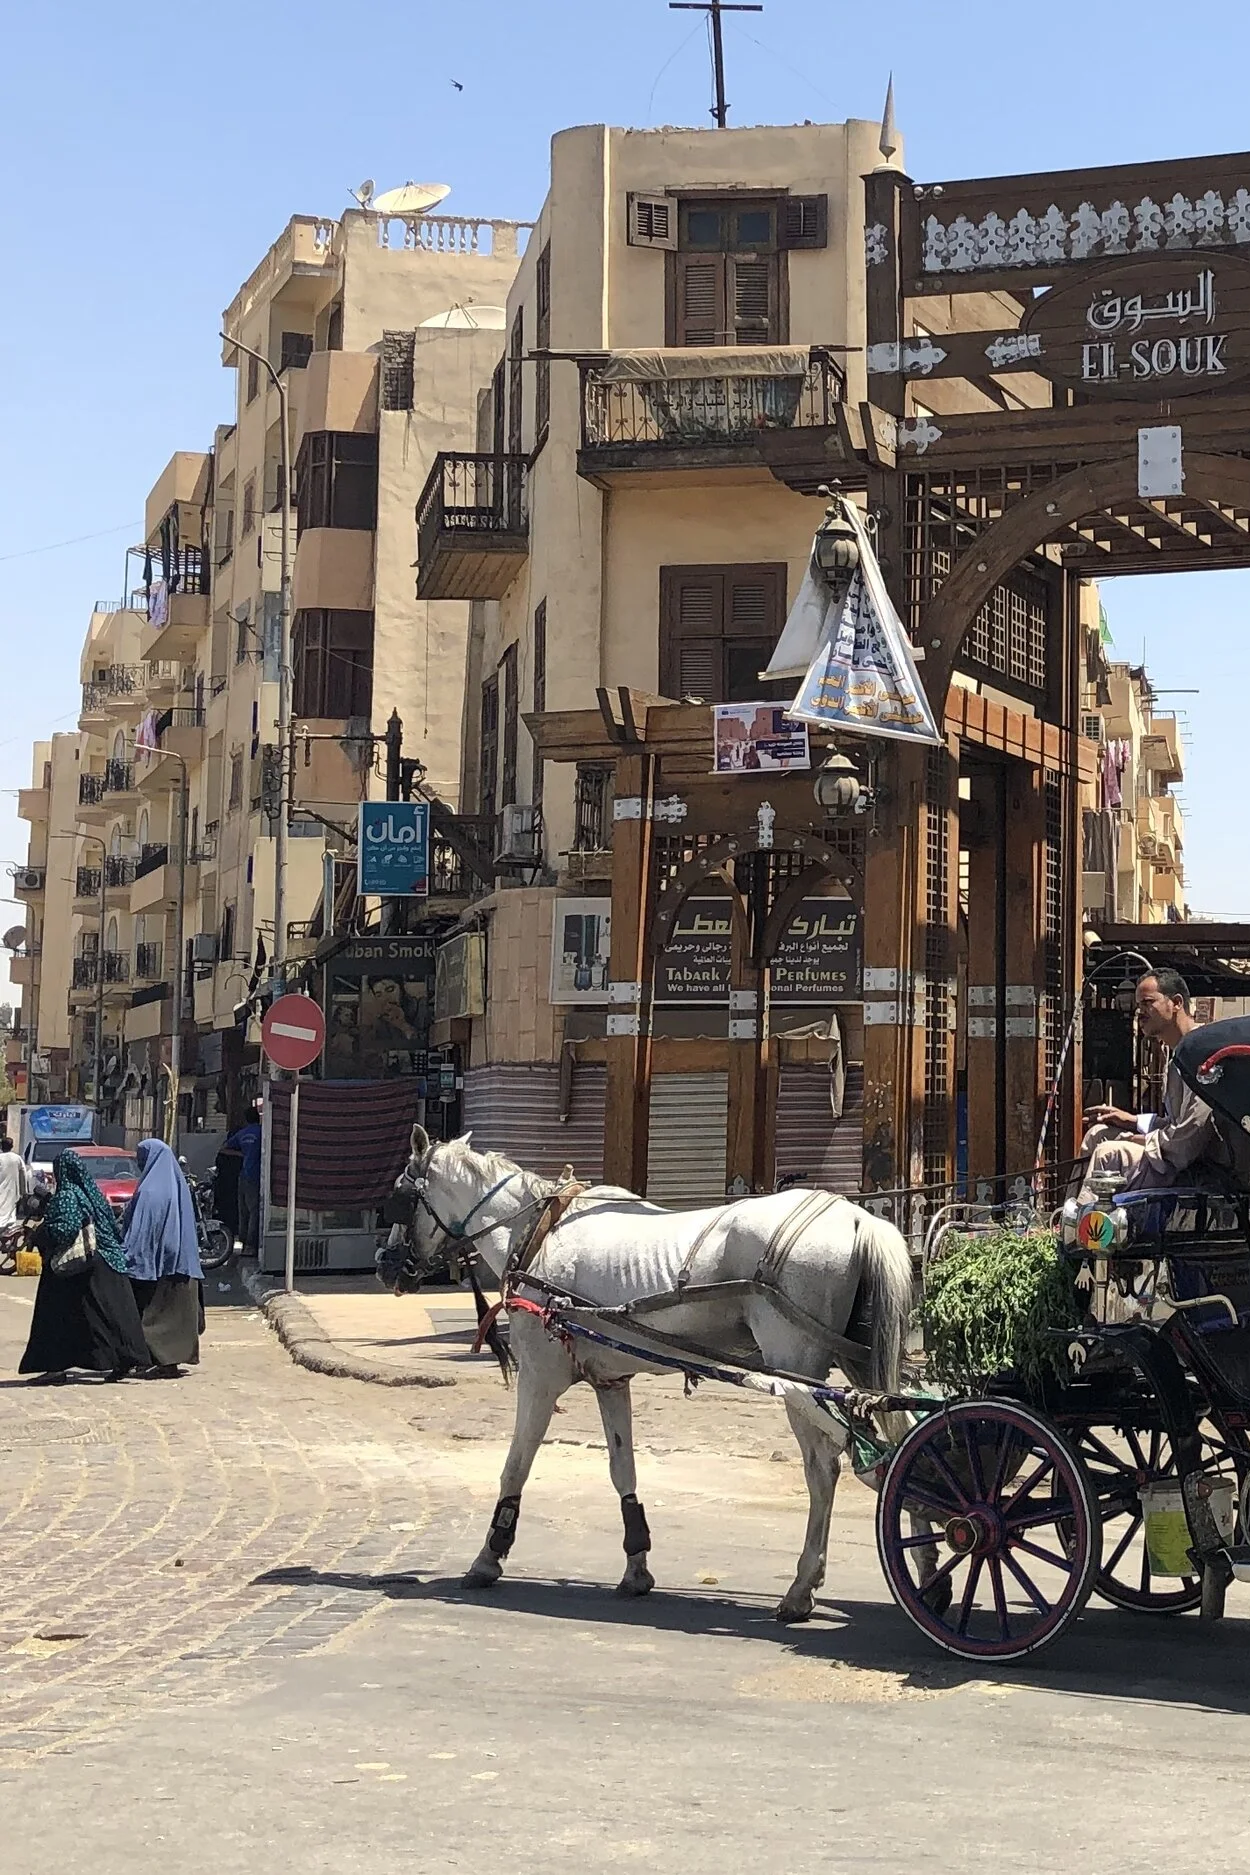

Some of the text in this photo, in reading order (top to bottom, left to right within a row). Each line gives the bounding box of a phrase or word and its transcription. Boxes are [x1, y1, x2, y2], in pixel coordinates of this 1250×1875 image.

[1086, 268, 1215, 333] السوق
[366, 805, 425, 843] أمان
[788, 914, 858, 941] تبارك
[342, 943, 382, 959] uban
[778, 942, 799, 953] البرف
[821, 942, 849, 953] لجميع
[667, 984, 684, 992] We
[686, 984, 710, 992] have
[712, 984, 725, 992] all
[795, 984, 845, 992] Perfumes
